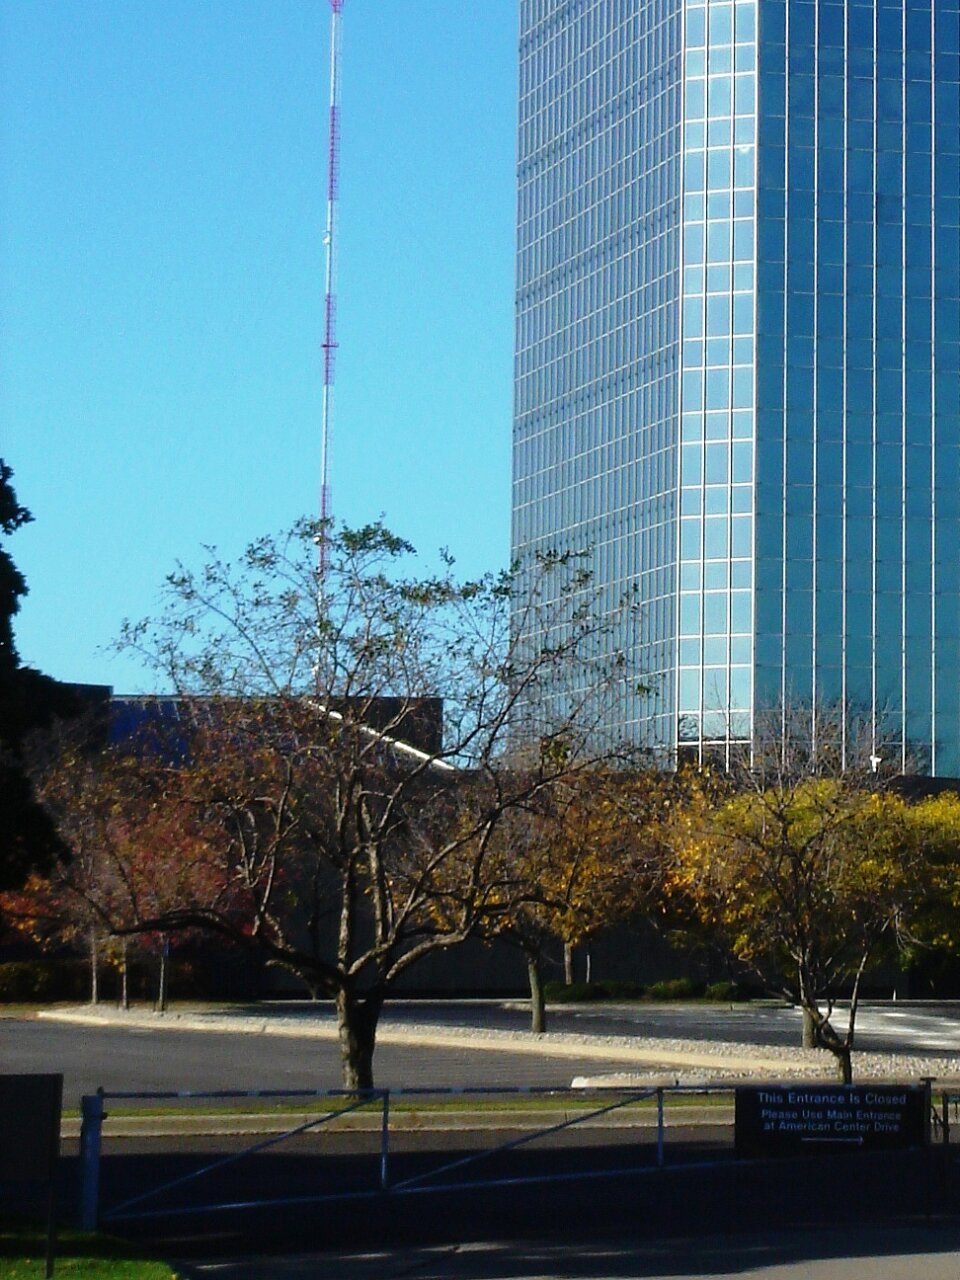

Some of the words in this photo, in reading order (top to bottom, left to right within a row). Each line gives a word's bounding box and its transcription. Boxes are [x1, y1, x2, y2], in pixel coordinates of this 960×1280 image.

[757, 1092, 783, 1104] This
[788, 1093, 845, 1104] Entrance
[850, 1093, 860, 1104] Is
[865, 1093, 907, 1105] Closed
[761, 1109, 798, 1119] Please
[802, 1109, 823, 1120] Use
[827, 1109, 852, 1120] Main
[856, 1110, 902, 1120] Entrance
[763, 1121, 775, 1130] at
[779, 1121, 831, 1131] American
[834, 1122, 870, 1132] Center
[874, 1122, 900, 1132] Drive
